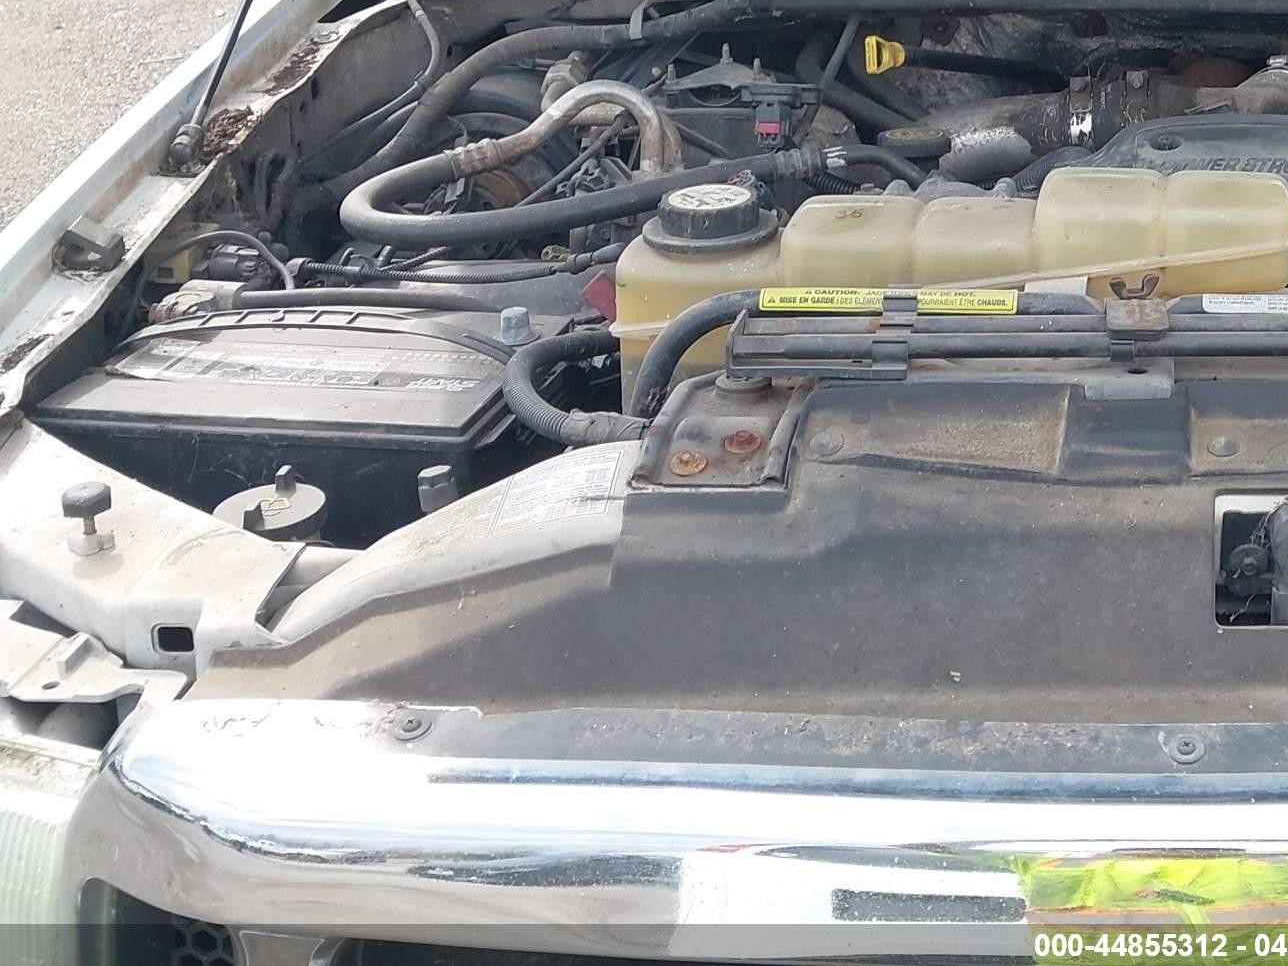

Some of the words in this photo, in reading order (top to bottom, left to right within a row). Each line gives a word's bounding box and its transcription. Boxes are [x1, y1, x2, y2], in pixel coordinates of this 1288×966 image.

[779, 296, 797, 304] MISE
[799, 296, 809, 304] EN
[976, 298, 1008, 307] CHAUDS.
